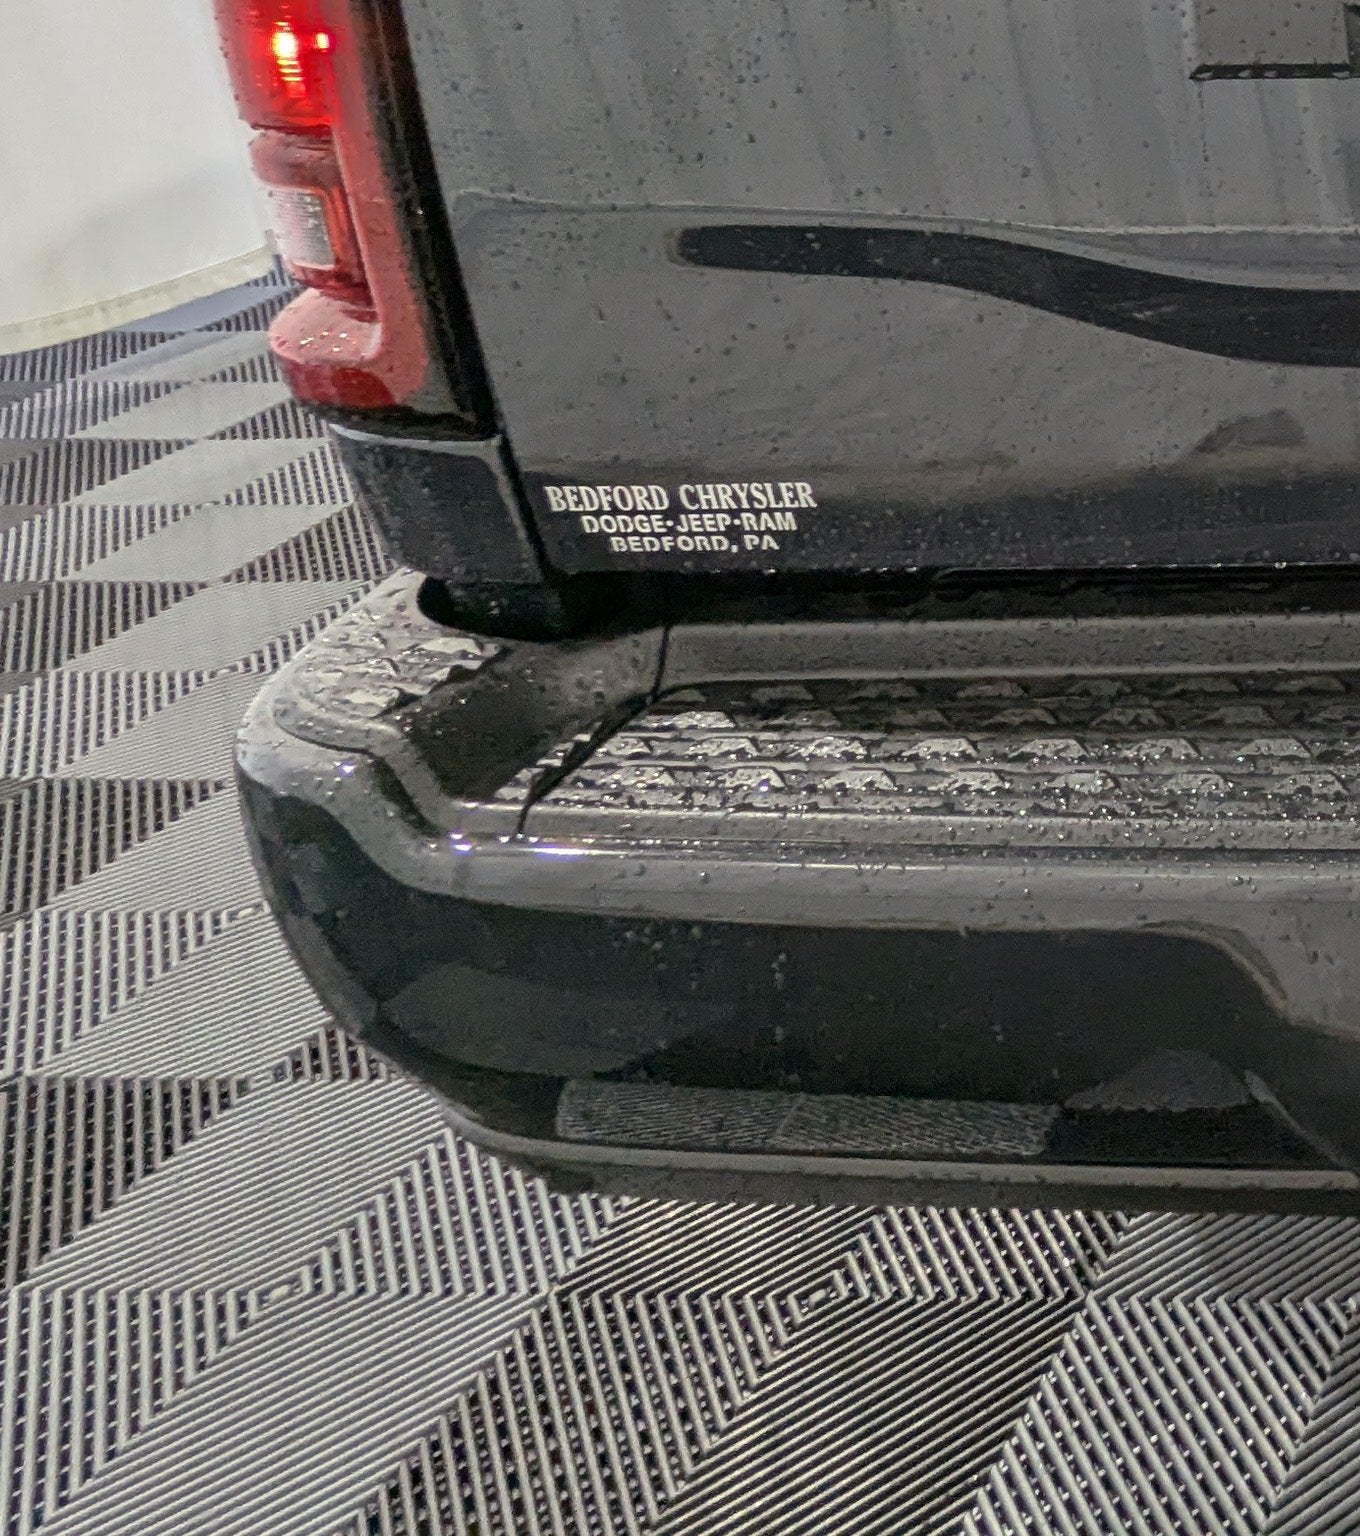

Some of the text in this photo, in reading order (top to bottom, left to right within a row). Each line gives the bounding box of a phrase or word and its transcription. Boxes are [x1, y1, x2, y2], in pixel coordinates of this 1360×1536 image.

[545, 482, 817, 512] BEDFORD CHRYSLER
[610, 534, 780, 553] BEDFORD, PA
